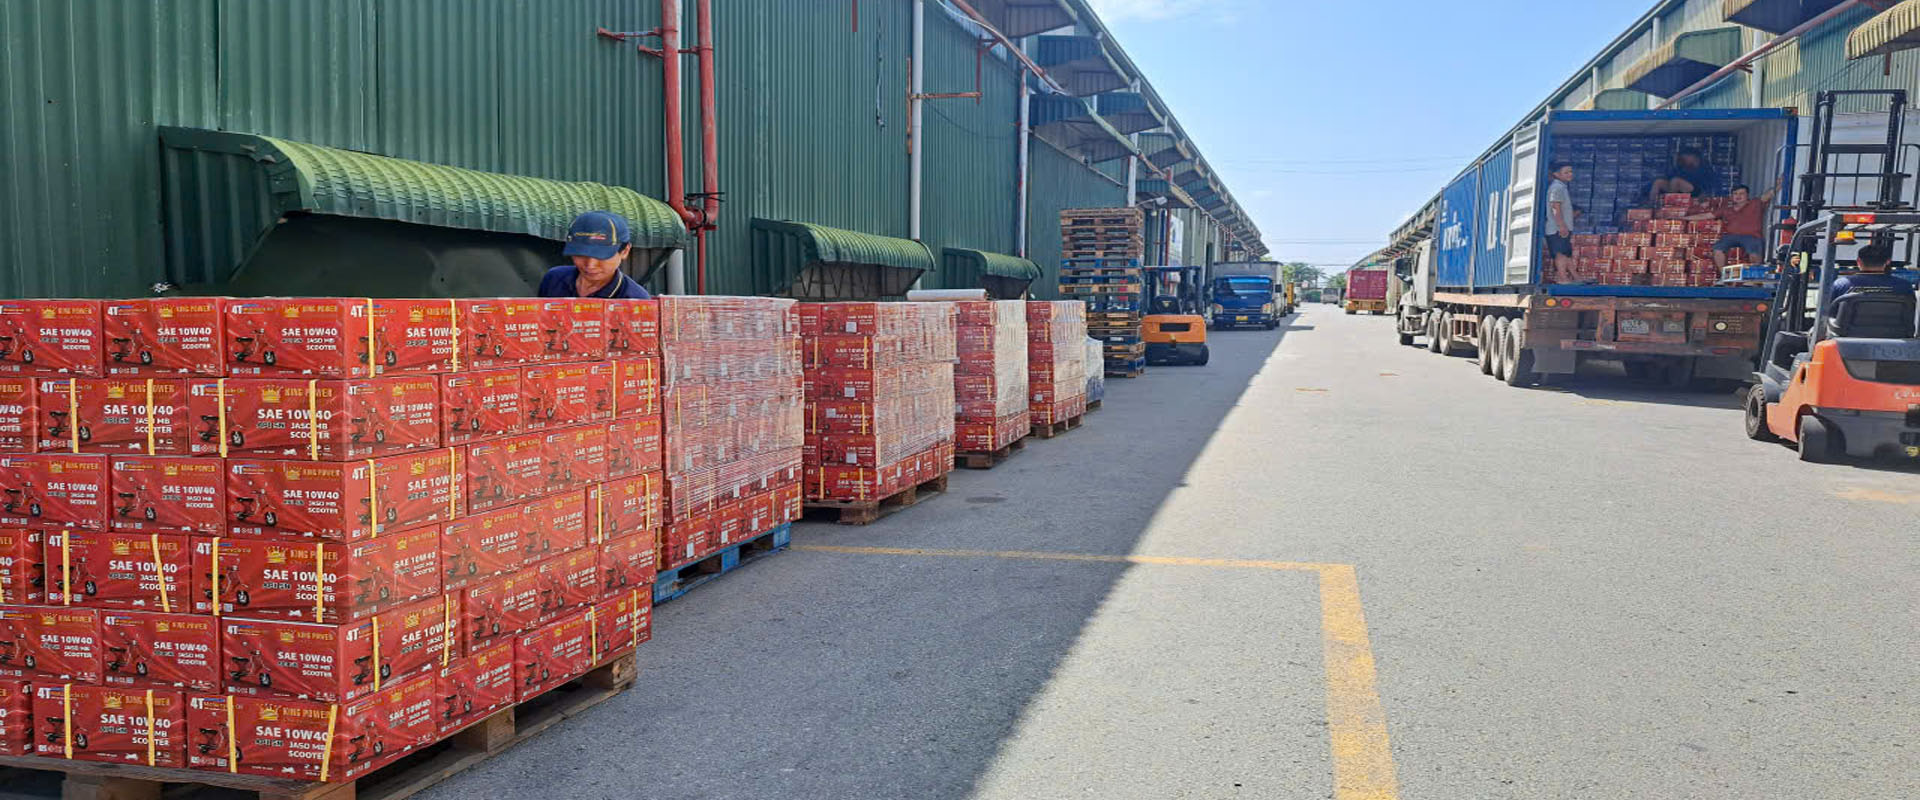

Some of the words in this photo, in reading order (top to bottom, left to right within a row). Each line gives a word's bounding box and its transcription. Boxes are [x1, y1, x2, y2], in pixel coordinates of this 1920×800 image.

[406, 327, 425, 337] SAE
[41, 382, 54, 393] 4T
[191, 384, 205, 396] 4T
[104, 405, 127, 414] SAE
[258, 409, 282, 418] SAE
[408, 479, 427, 491] SAE
[430, 473, 461, 487] 10W0
[49, 536, 62, 547] 4T
[196, 543, 210, 555] 4T
[109, 560, 132, 570] SAE
[264, 570, 288, 580] SAE
[401, 628, 421, 644] SAE
[424, 618, 455, 637] 10W0
[300, 654, 332, 662] 10W40
[38, 688, 50, 699] 4T
[191, 699, 204, 709] 4T
[101, 714, 124, 724] SAE
[255, 726, 280, 737] SAE
[289, 751, 325, 761] SCOOTE
